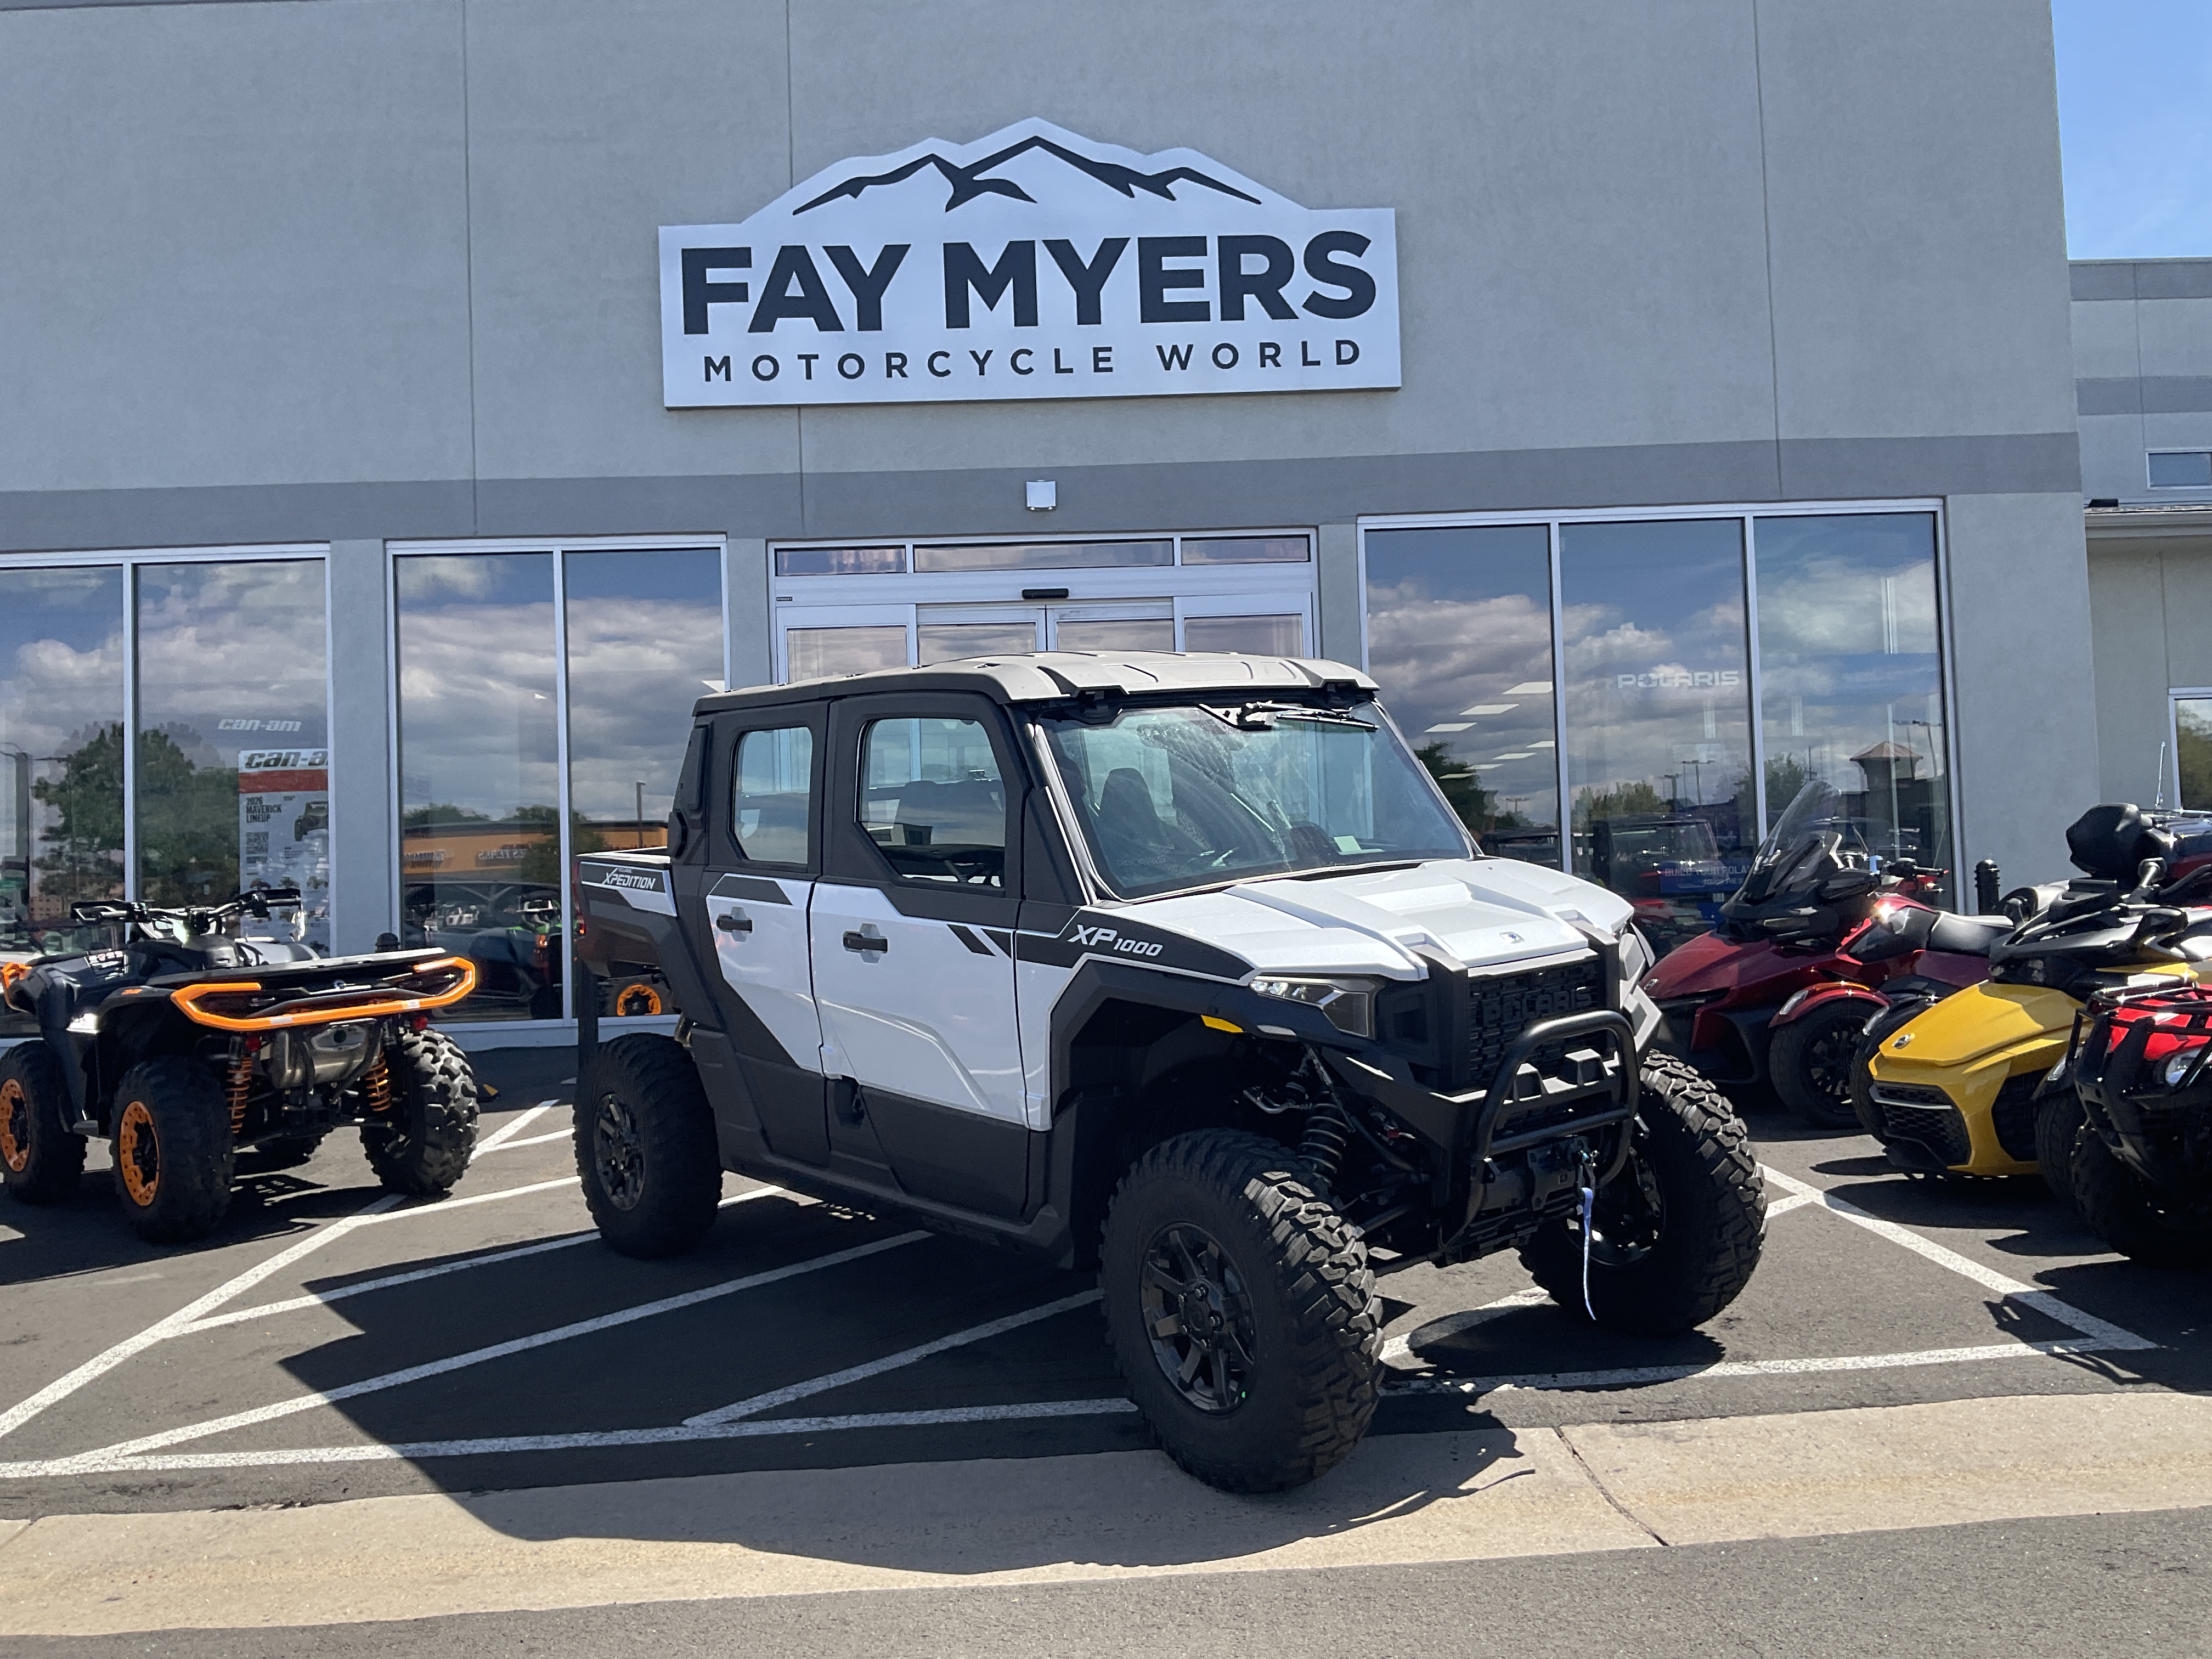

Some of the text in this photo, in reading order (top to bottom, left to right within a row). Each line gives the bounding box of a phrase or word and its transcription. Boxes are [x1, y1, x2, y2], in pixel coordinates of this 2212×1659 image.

[681, 230, 1376, 335] FAY MYERS
[704, 340, 1359, 382] MOTORCYCLE WORLD
[1617, 670, 1740, 689] POLARIS
[218, 719, 302, 732] can-am
[245, 751, 328, 769] can-a
[246, 804, 282, 814] MAVERICK
[602, 867, 656, 890] XPEDITION
[1067, 924, 1163, 956] XP 1000
